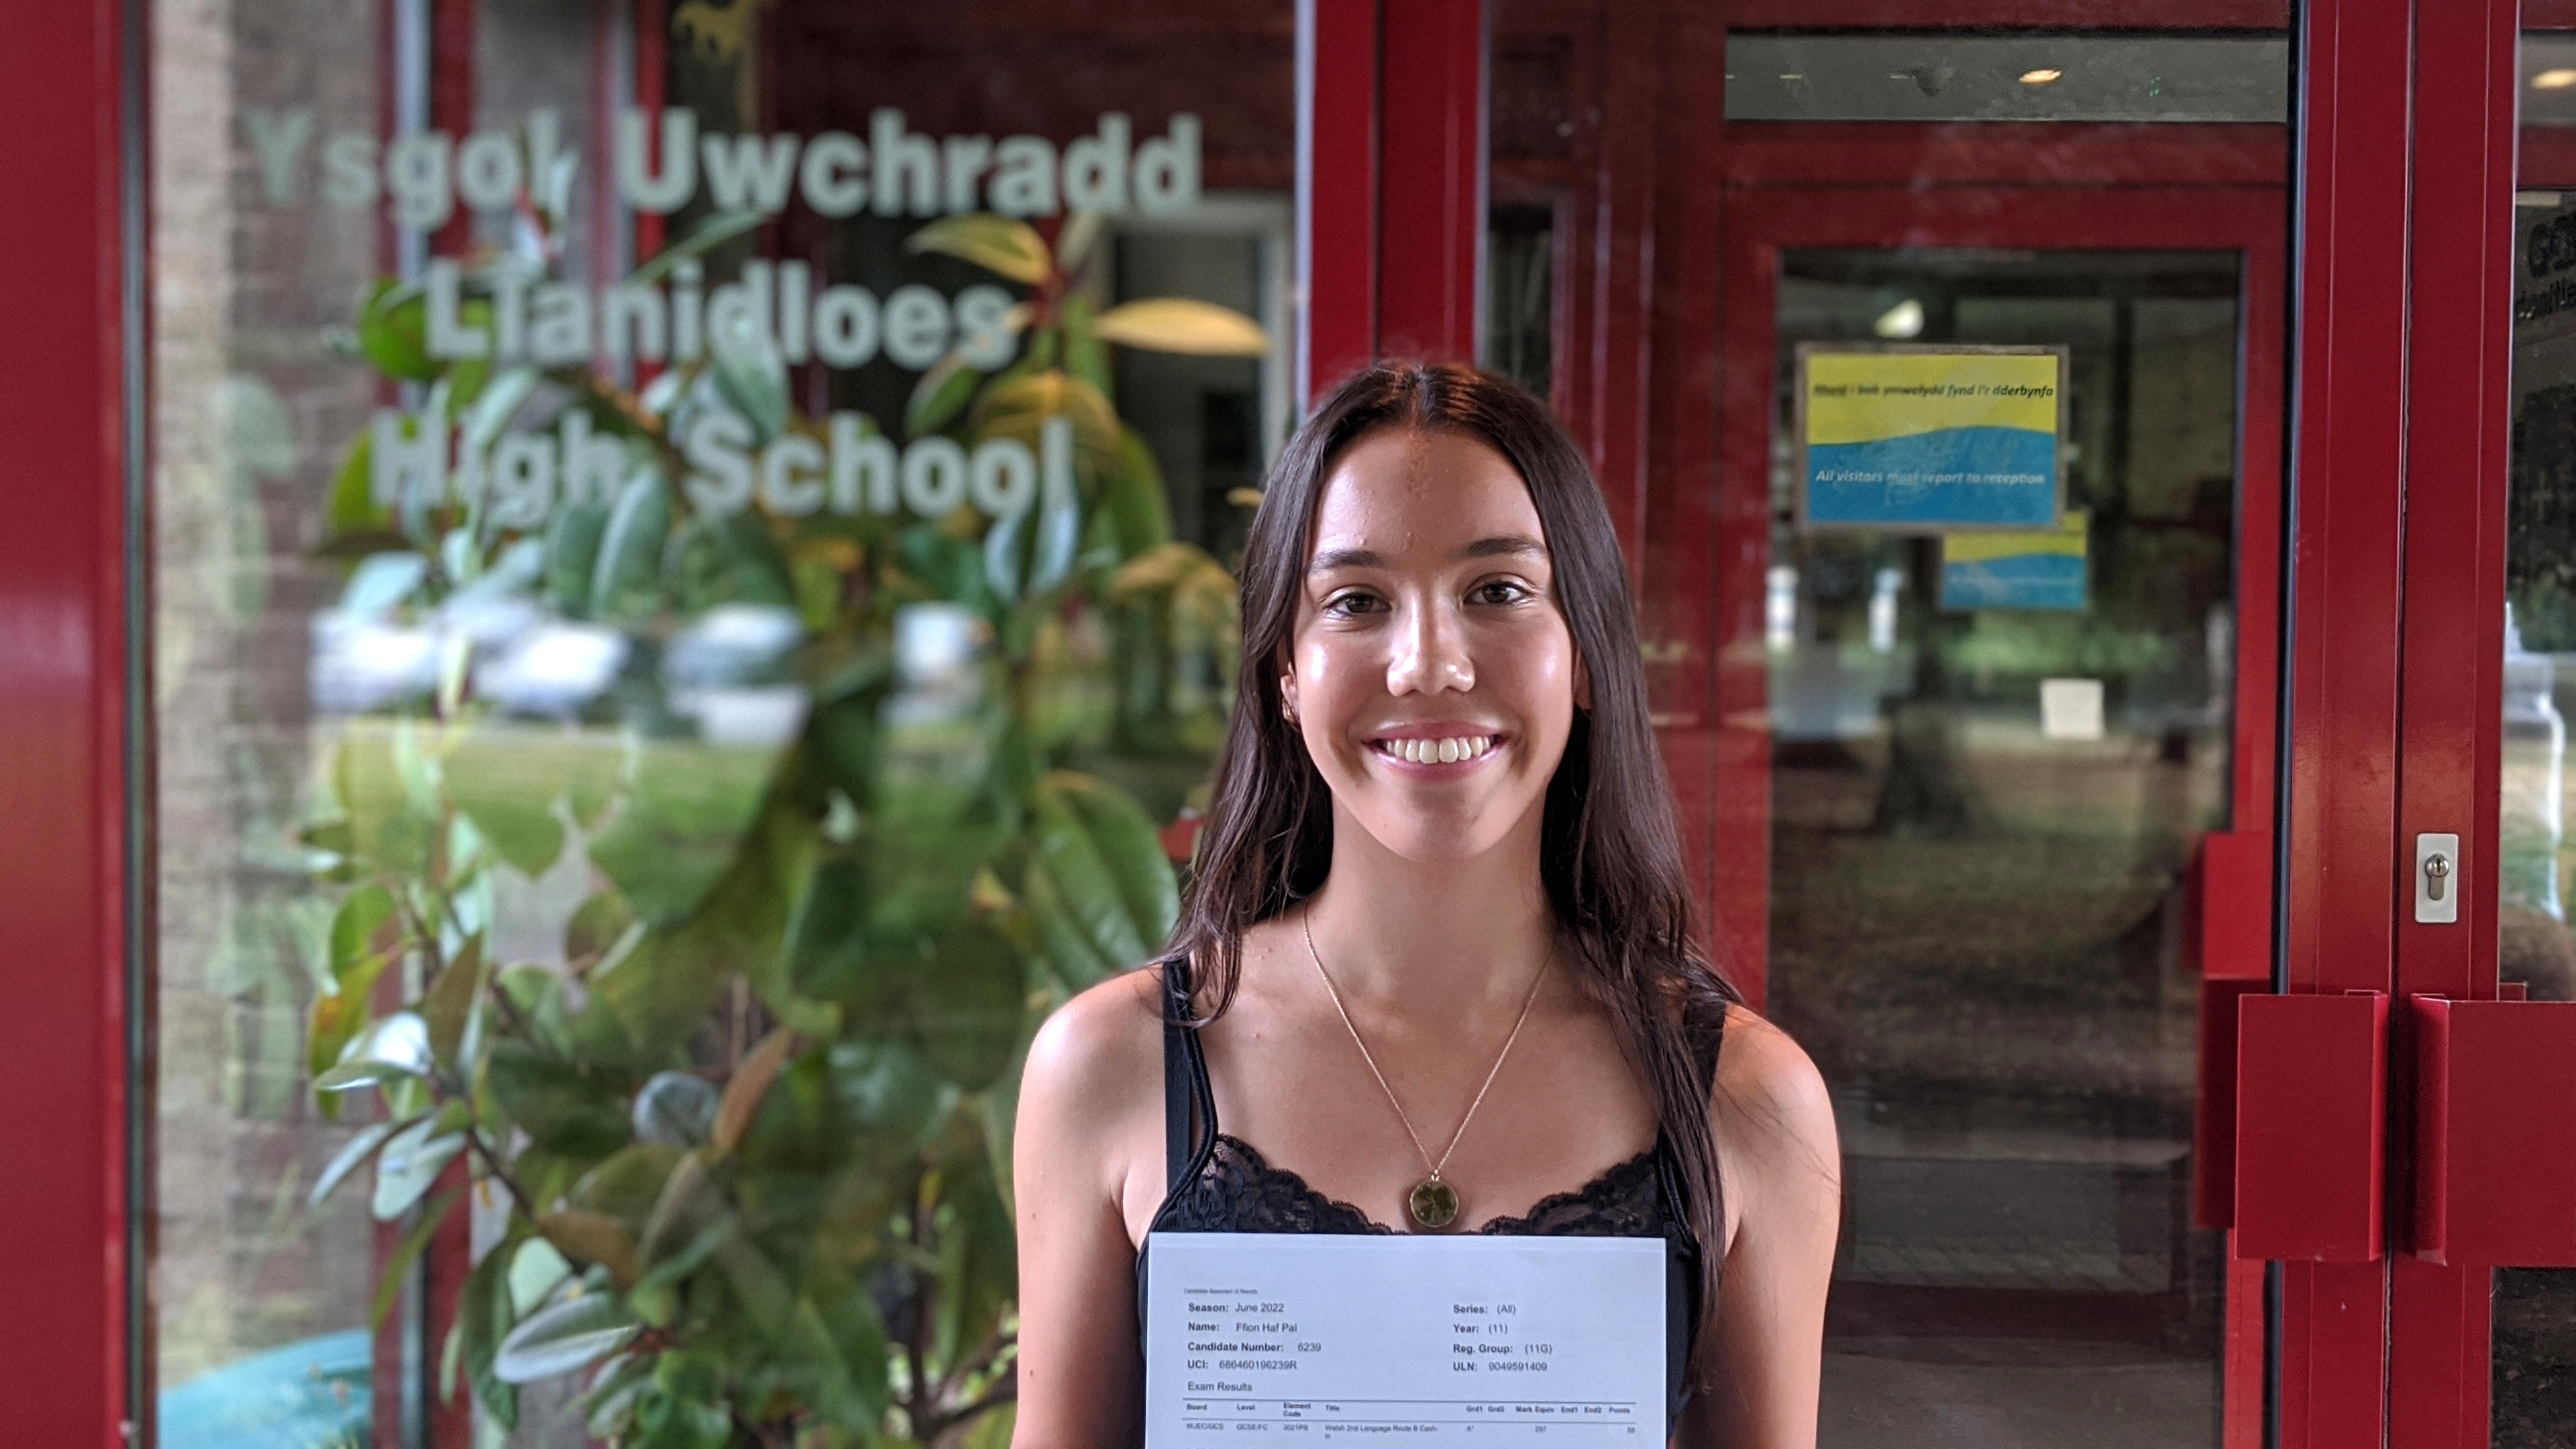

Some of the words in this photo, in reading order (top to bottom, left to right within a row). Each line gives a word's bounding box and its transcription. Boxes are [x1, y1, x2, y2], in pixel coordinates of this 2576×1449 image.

[244, 105, 561, 233] Ysgol
[616, 105, 1203, 219] Uwchradd
[424, 258, 1020, 371] Llanidloes
[1947, 384, 1975, 397] fynd
[1992, 385, 2053, 398] dderbynfa
[371, 407, 629, 529] High
[684, 409, 1073, 518] School
[1816, 470, 1833, 481] All
[1837, 470, 1883, 482] visitors
[1887, 471, 1919, 482] must
[1923, 472, 1963, 485] report
[1966, 472, 1980, 484] to
[1984, 472, 2045, 485] reception
[1188, 1303, 1228, 1312] Season:
[1235, 1303, 1258, 1312] June
[1260, 1303, 1285, 1312] 2022
[1453, 1304, 1488, 1313] Series:
[1497, 1304, 1516, 1315] (All)
[1188, 1322, 1220, 1332] Name:
[1236, 1323, 1260, 1332] Ffion
[1263, 1323, 1279, 1332] Haf
[1282, 1323, 1297, 1332] Pal
[1453, 1324, 1479, 1333] Year:
[1489, 1324, 1508, 1334] (11)
[1188, 1342, 1238, 1352] Candidate
[1241, 1342, 1283, 1352] Number:
[1298, 1343, 1322, 1352] 6239
[1453, 1344, 1475, 1354] Reg.
[1479, 1344, 1513, 1354] Group:
[1525, 1344, 1552, 1355] (11G)
[1187, 1360, 1208, 1369] UCI:
[1453, 1362, 1478, 1371] ULN:
[1188, 1381, 1215, 1391] Exam
[1218, 1382, 1253, 1391] Results
[1535, 1406, 1554, 1414] Equiv
[1360, 1425, 1391, 1433] Language
